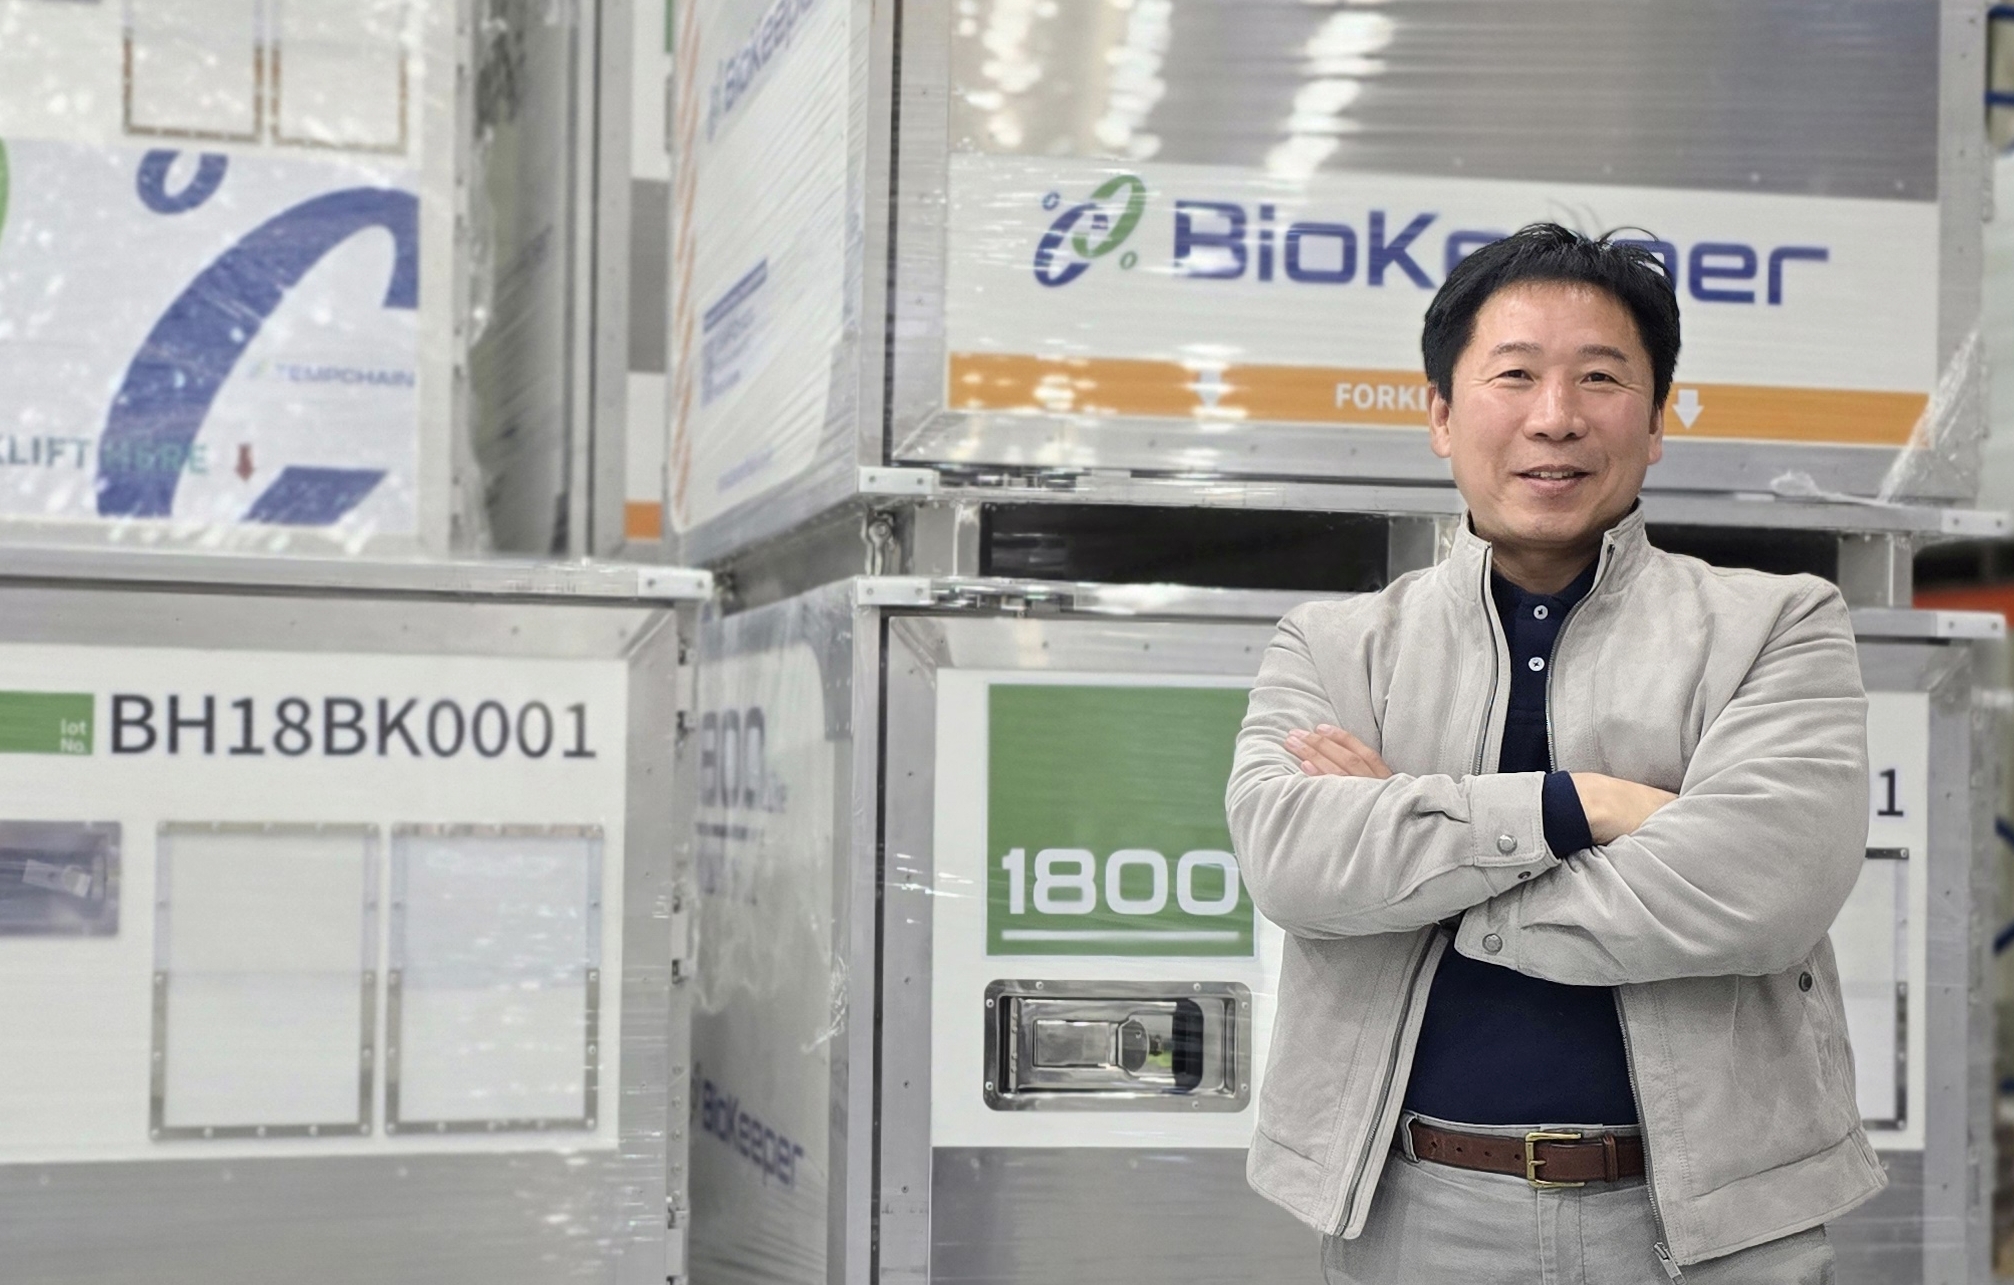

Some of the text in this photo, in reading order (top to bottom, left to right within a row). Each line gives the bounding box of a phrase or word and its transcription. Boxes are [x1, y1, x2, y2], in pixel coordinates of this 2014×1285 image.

[1174, 199, 1829, 306] BioKer
[61, 717, 87, 736] lot
[110, 694, 598, 758] BH18BK0001
[1002, 847, 1240, 915] 1800
